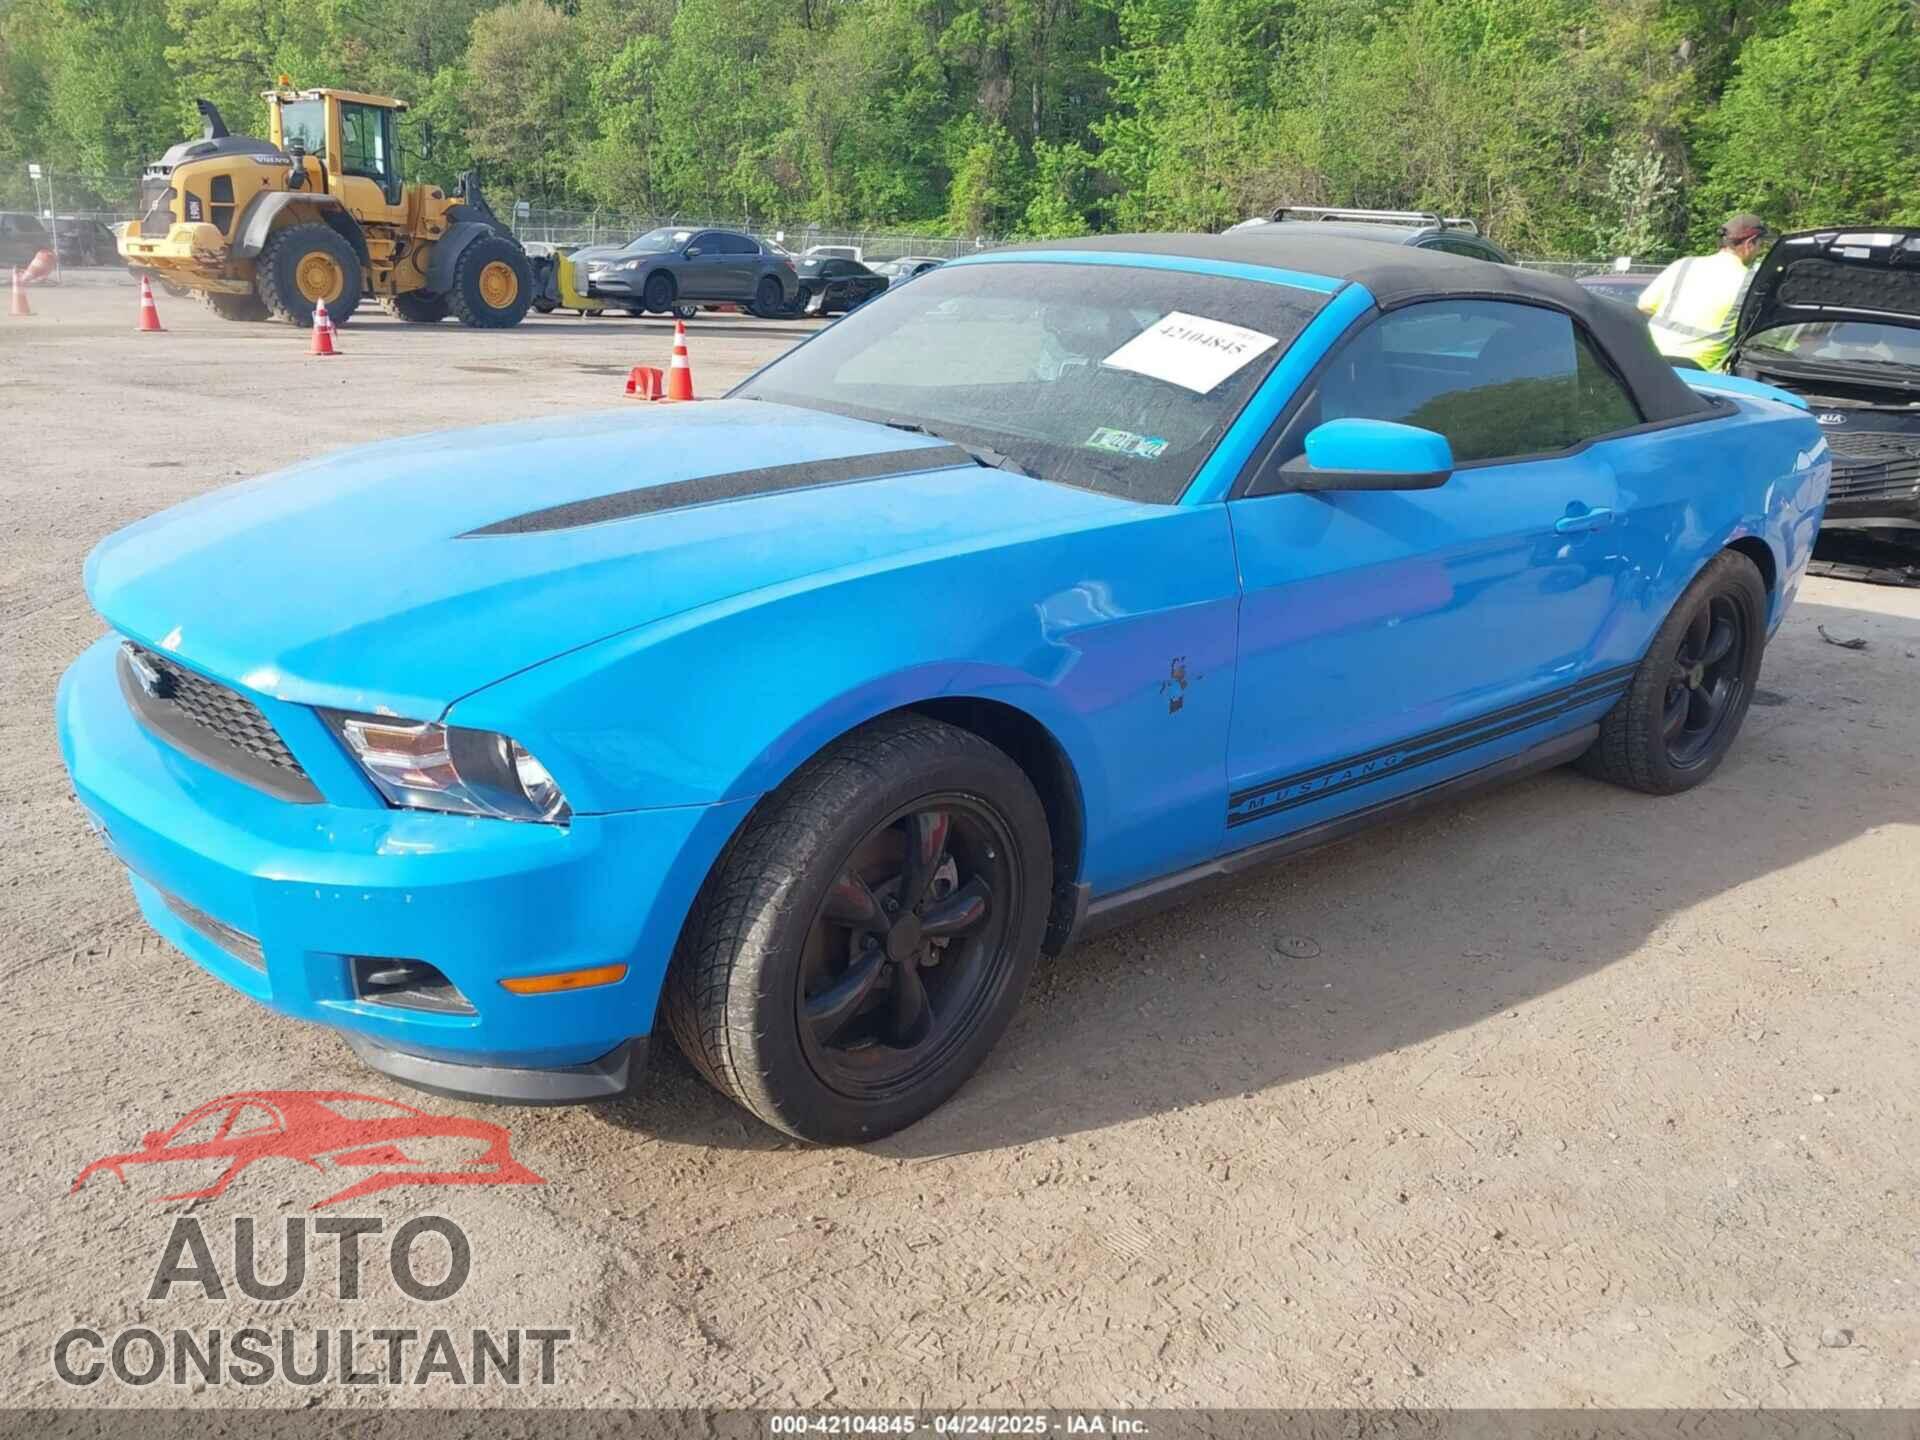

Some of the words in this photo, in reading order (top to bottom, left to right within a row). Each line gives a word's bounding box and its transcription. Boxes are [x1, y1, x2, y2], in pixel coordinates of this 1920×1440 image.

[1160, 325, 1247, 355] 42104845
[1818, 414, 1843, 423] KIA
[1248, 754, 1400, 810] MUSTANG
